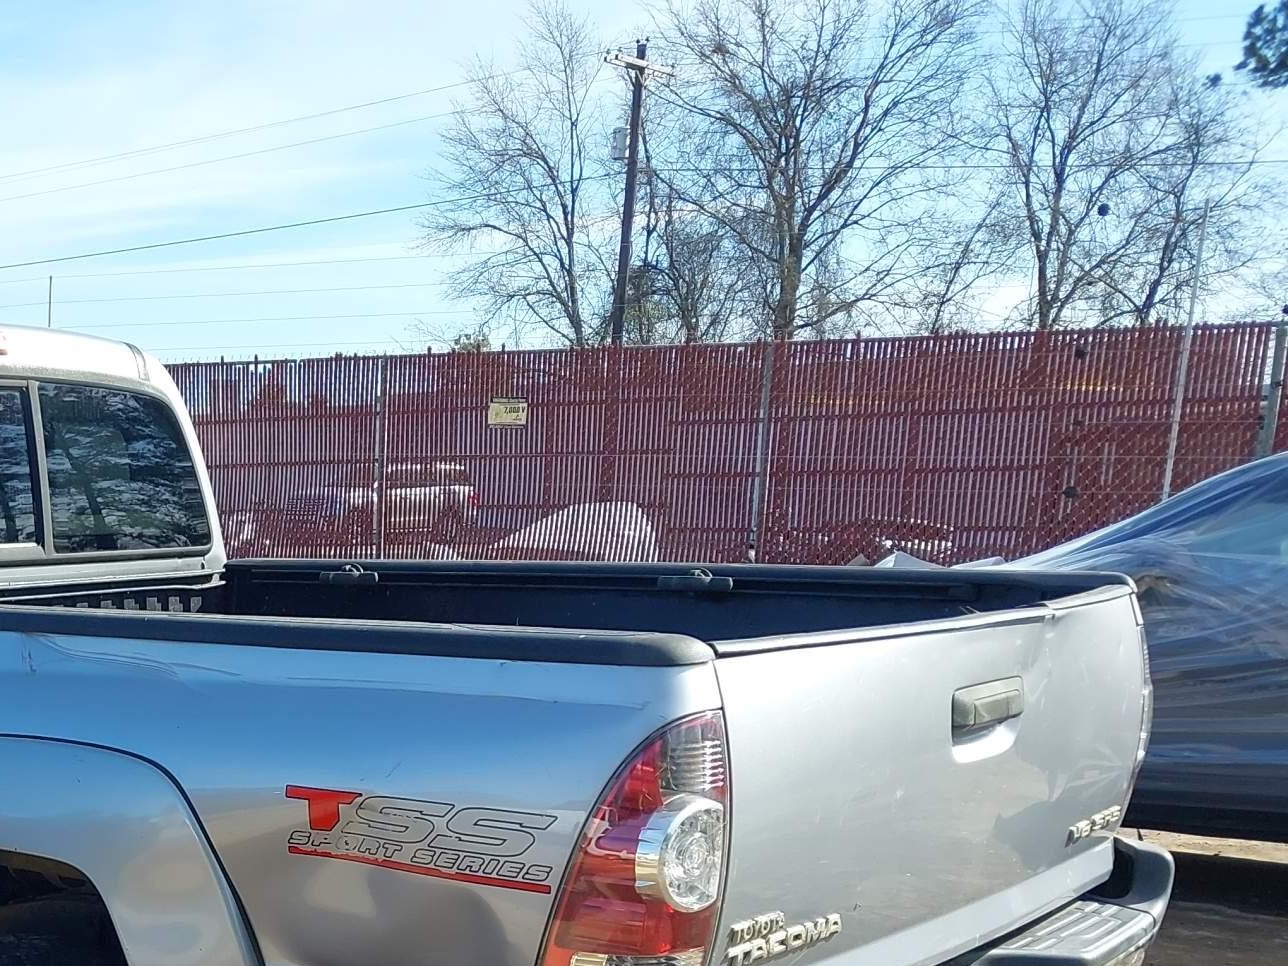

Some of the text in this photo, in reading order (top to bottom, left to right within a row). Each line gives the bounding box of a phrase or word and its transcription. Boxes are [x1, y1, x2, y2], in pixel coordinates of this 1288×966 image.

[285, 784, 559, 858] TSS
[287, 830, 554, 882] SPORT SERIES
